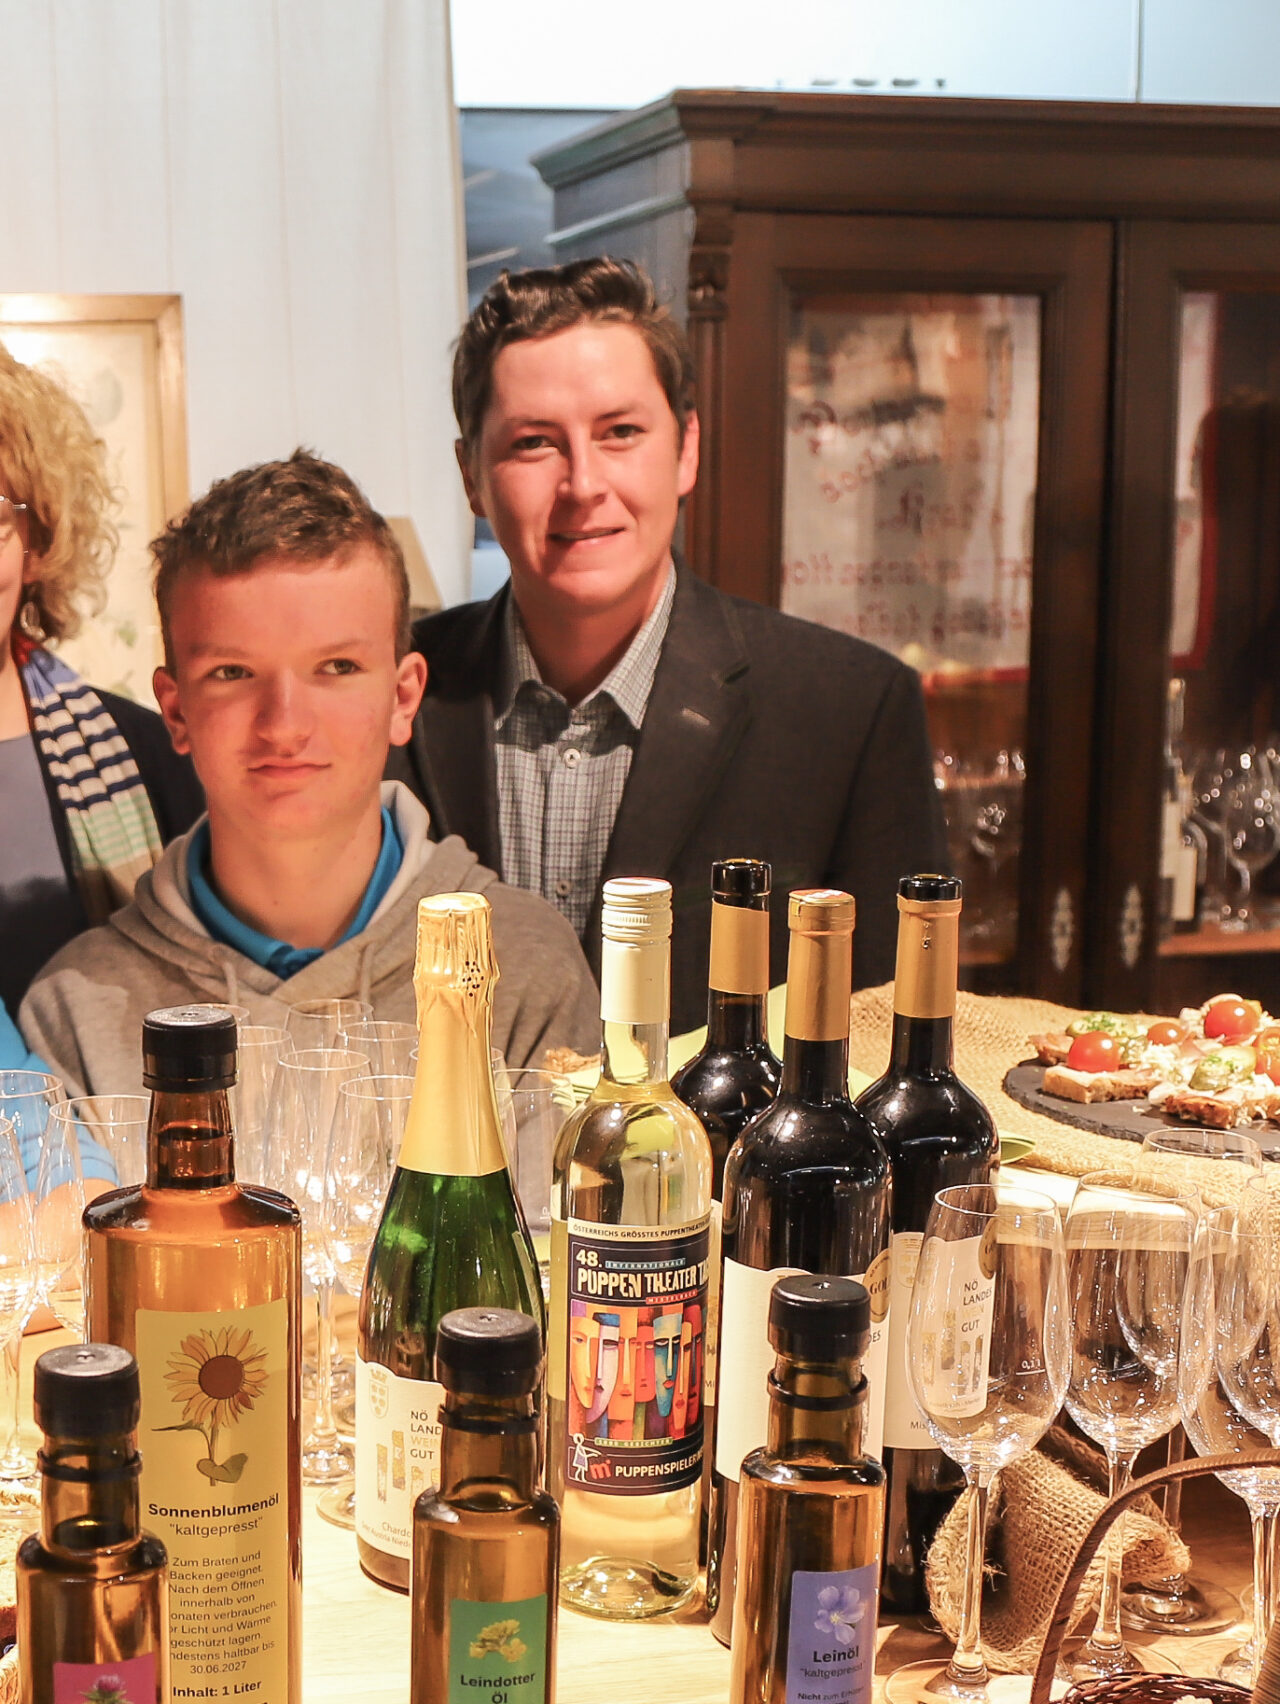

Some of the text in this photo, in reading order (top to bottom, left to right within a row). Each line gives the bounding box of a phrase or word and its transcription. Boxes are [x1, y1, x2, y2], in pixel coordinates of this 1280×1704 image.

[576, 1249, 603, 1268] 48.
[577, 1267, 642, 1298] PUPPEN
[644, 1264, 697, 1293] THEATER
[961, 1318, 980, 1333] GUT
[410, 1409, 428, 1421] NÖ
[410, 1448, 435, 1460] GUT
[148, 1493, 279, 1518] Sonnenblumenöl
[172, 1550, 261, 1567] Zum Braten und
[170, 1571, 212, 1581] Backen
[169, 1583, 199, 1594] Nach
[202, 1585, 228, 1594] dem
[180, 1594, 255, 1608] innerhalb von
[181, 1625, 209, 1634] Licht
[212, 1624, 233, 1633] und
[223, 1646, 260, 1659] haltbar
[262, 1641, 275, 1651] bis
[813, 1645, 859, 1663] Leinöl
[190, 1660, 247, 1674] 30.06.2027
[461, 1673, 536, 1688] Leindotter
[173, 1681, 262, 1697] Inhalt: 1 Liter
[491, 1690, 508, 1704] Öl
